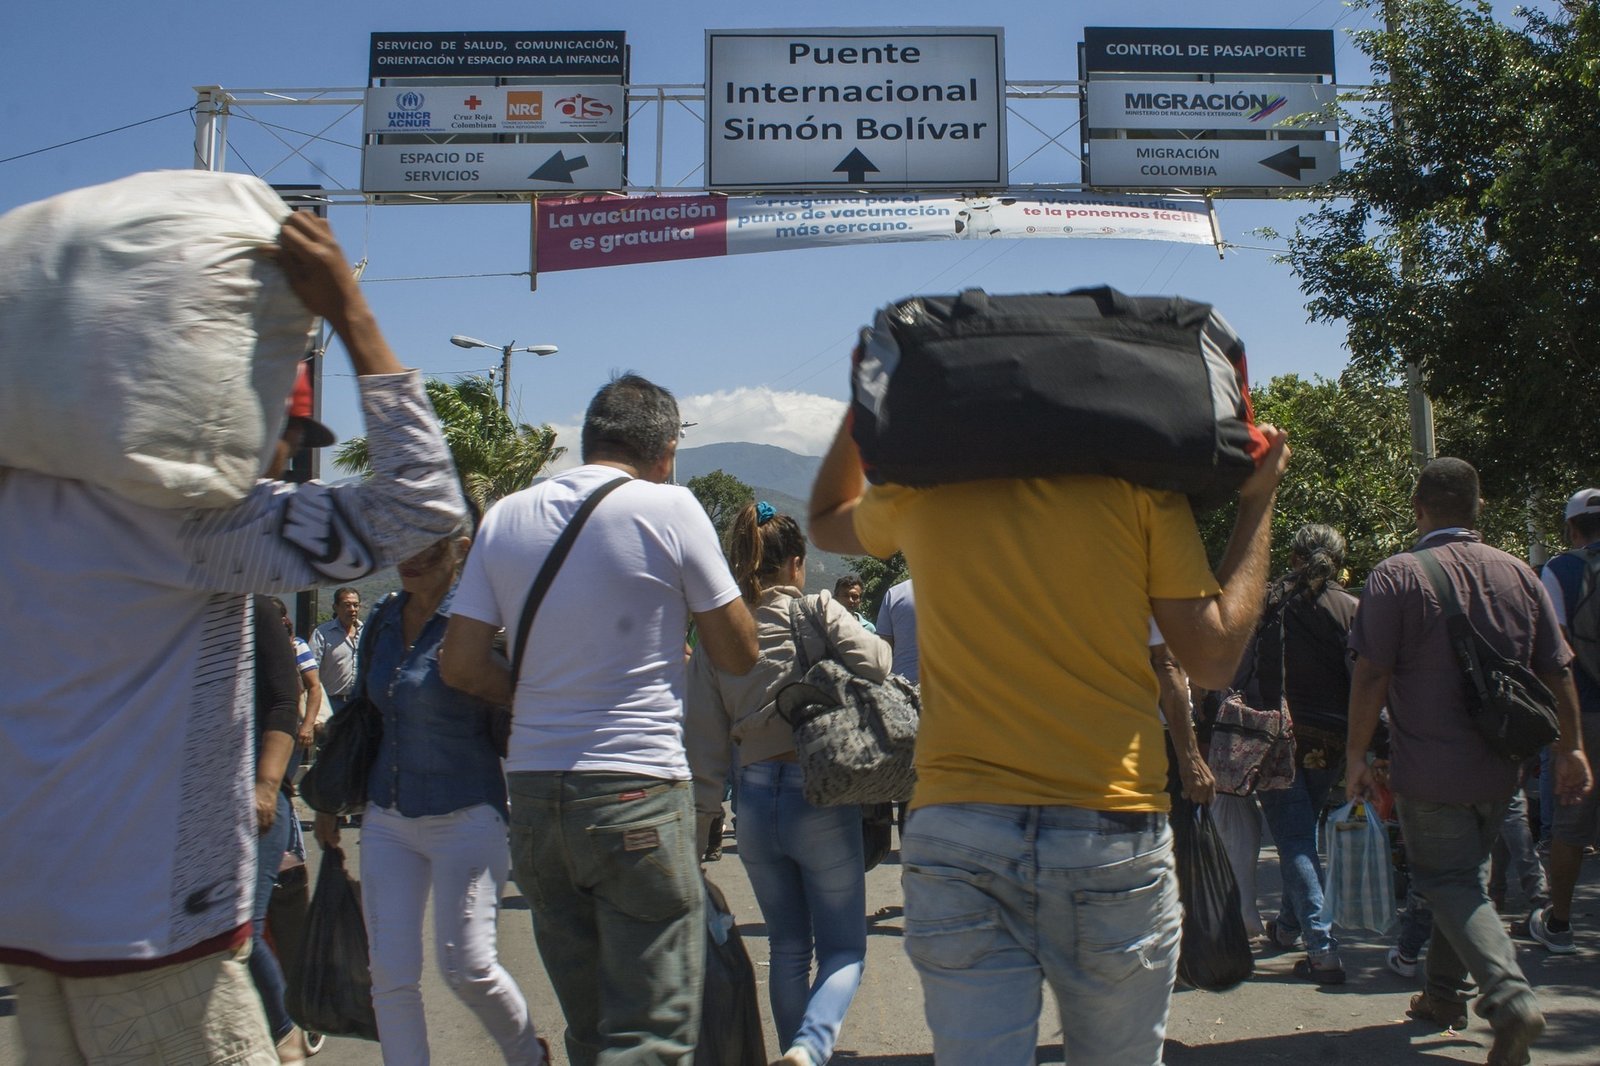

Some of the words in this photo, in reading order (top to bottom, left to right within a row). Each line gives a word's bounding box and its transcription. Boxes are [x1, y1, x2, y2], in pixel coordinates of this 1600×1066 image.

[376, 41, 433, 50] SERVICIO
[440, 41, 456, 50] DE
[463, 41, 507, 51] SALUD,
[515, 39, 619, 50] COMUNICACIÓN,
[1106, 43, 1184, 56] CONTROL
[1188, 45, 1209, 56] DE
[1213, 45, 1306, 58] PASAPORTE
[377, 54, 454, 65] ORIENTACIÓN
[457, 56, 465, 65] Y
[467, 55, 514, 65] ESPACIO
[516, 55, 547, 64] PARA
[549, 55, 563, 64] LA
[566, 55, 620, 64] INFANCIA
[789, 43, 920, 64] Puente
[726, 78, 977, 103] Internacional
[1125, 90, 1267, 110] MIGRACIÓN
[388, 112, 431, 120] UNHCR
[508, 103, 540, 116] NRC
[388, 120, 431, 128] ACNUR
[723, 115, 843, 140] Simón
[856, 116, 987, 140] Bolívar
[400, 152, 460, 164] ESPACIO
[465, 152, 485, 163] DE
[1136, 146, 1219, 159] MIGRACIÓN
[404, 170, 480, 182] SERVICIOS
[1140, 165, 1217, 176] COLOMBIA
[865, 196, 898, 206] por
[902, 195, 920, 204] el
[1127, 200, 1144, 208] al
[549, 212, 573, 229] La
[579, 202, 716, 227] vacunación
[738, 211, 797, 228] punto
[801, 208, 826, 219] de
[830, 205, 950, 218] vacunación
[1023, 207, 1041, 215] te
[1045, 207, 1062, 216] la
[1066, 209, 1150, 219] ponemos
[1152, 211, 1198, 222] fácil!
[776, 223, 820, 238] más
[824, 221, 913, 234] cercano.
[569, 236, 595, 250] es
[600, 226, 695, 253] gratuita
